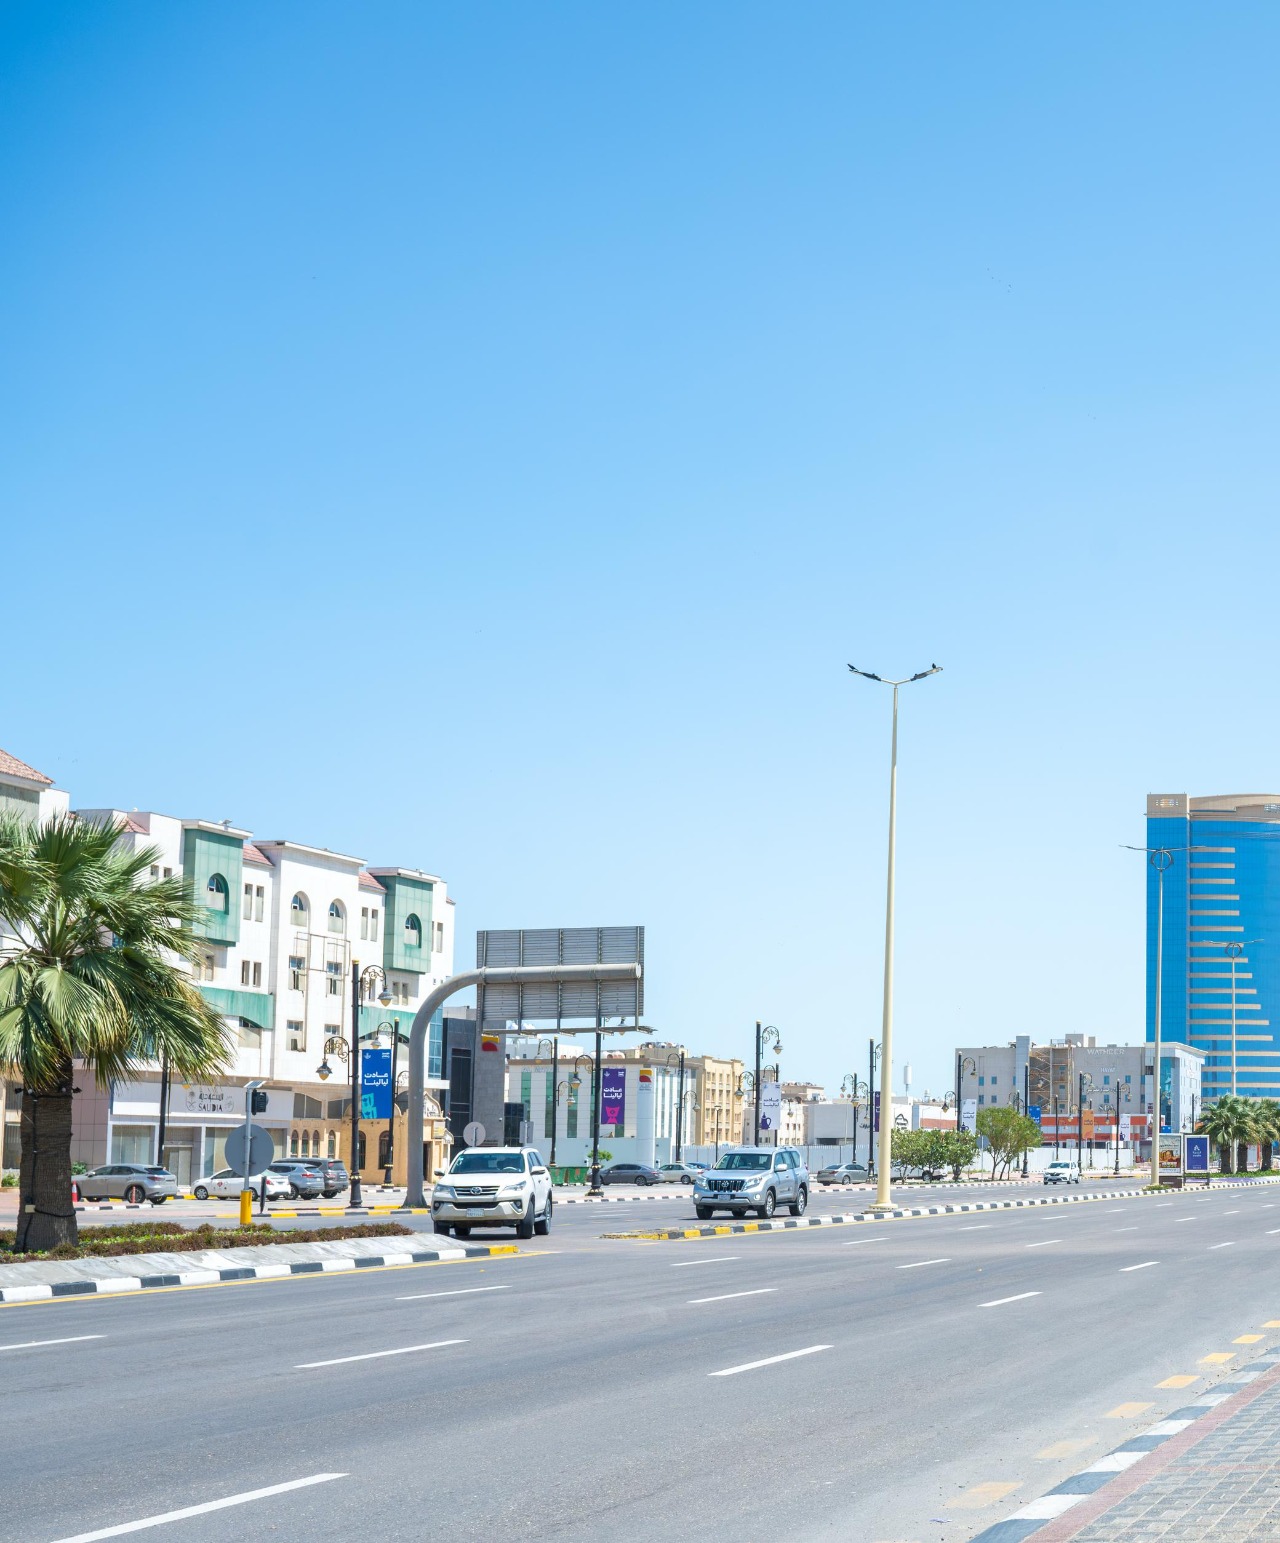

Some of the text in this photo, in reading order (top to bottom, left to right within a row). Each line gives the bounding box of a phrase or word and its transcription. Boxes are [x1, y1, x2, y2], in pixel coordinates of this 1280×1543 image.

[364, 1078, 389, 1087] ليالينا
[603, 1092, 623, 1100] ليالينا
[198, 1103, 223, 1112] SAUDIA
